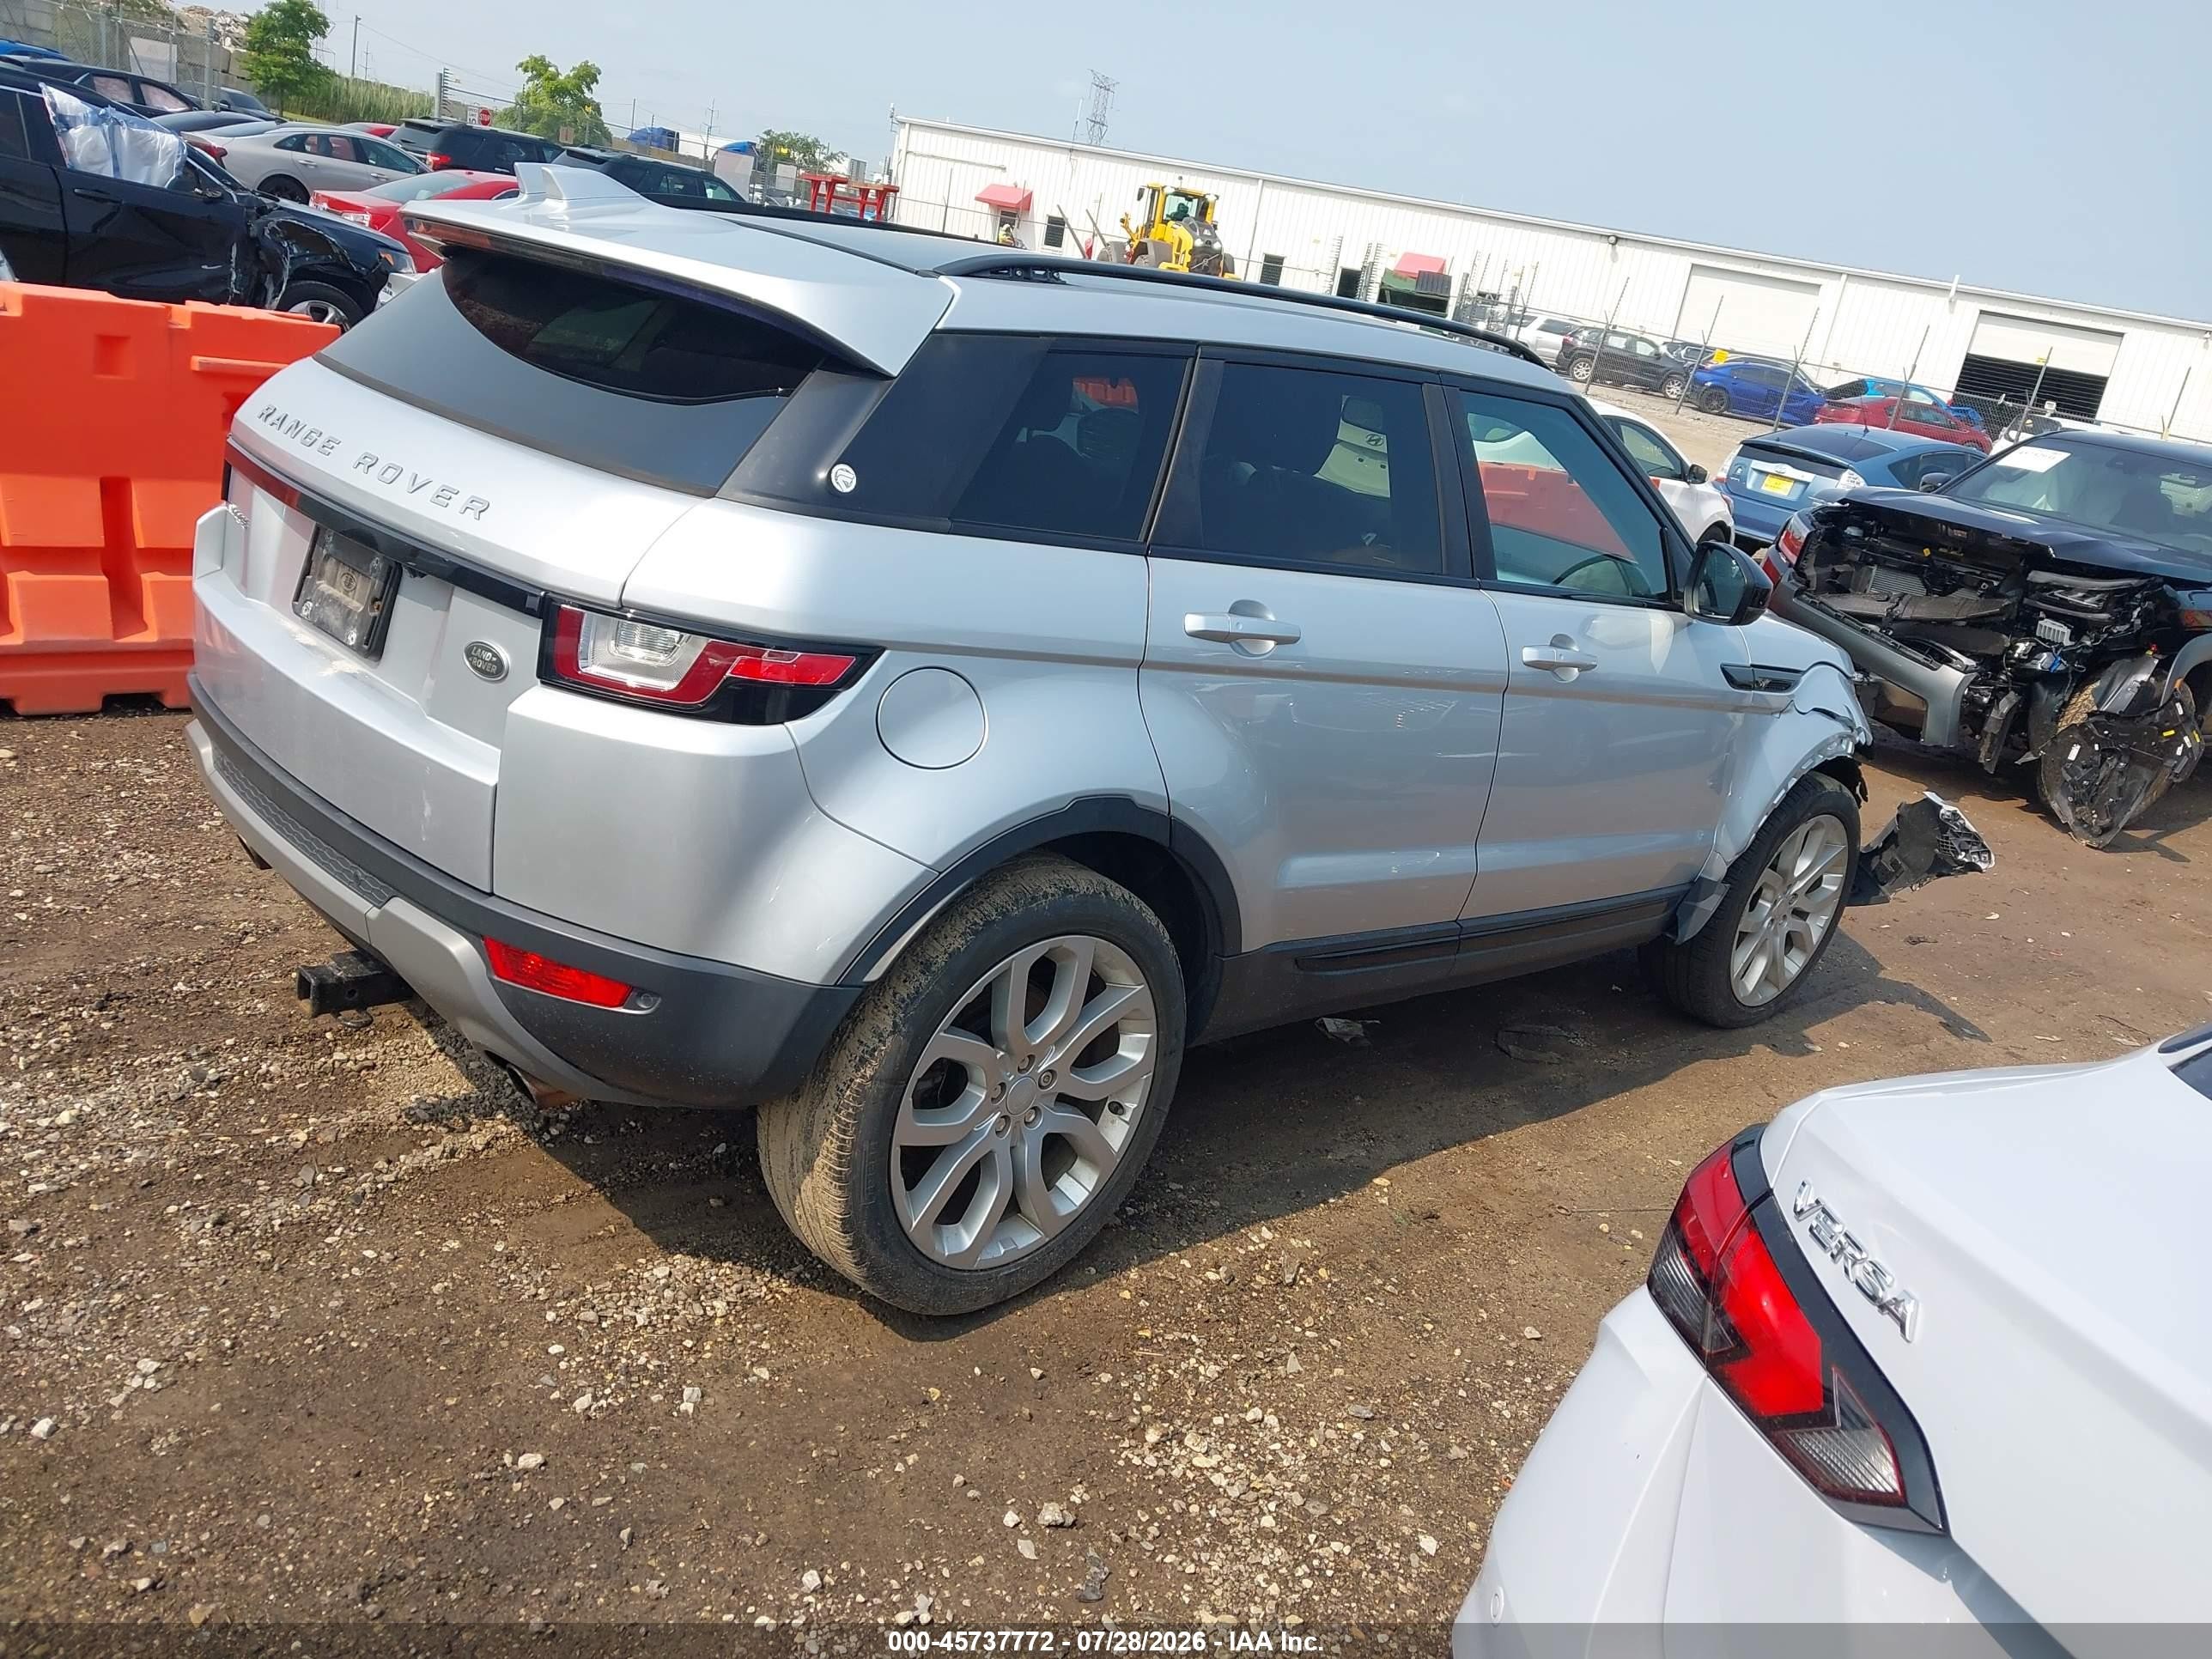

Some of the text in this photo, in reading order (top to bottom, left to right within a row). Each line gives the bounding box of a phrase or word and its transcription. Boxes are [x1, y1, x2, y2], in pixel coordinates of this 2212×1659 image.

[480, 113, 490, 122] STOP
[256, 404, 490, 520] RANGE ROVER
[471, 646, 493, 661] LAND
[471, 657, 498, 674] ROVER
[1793, 1180, 1918, 1344] VERSA
